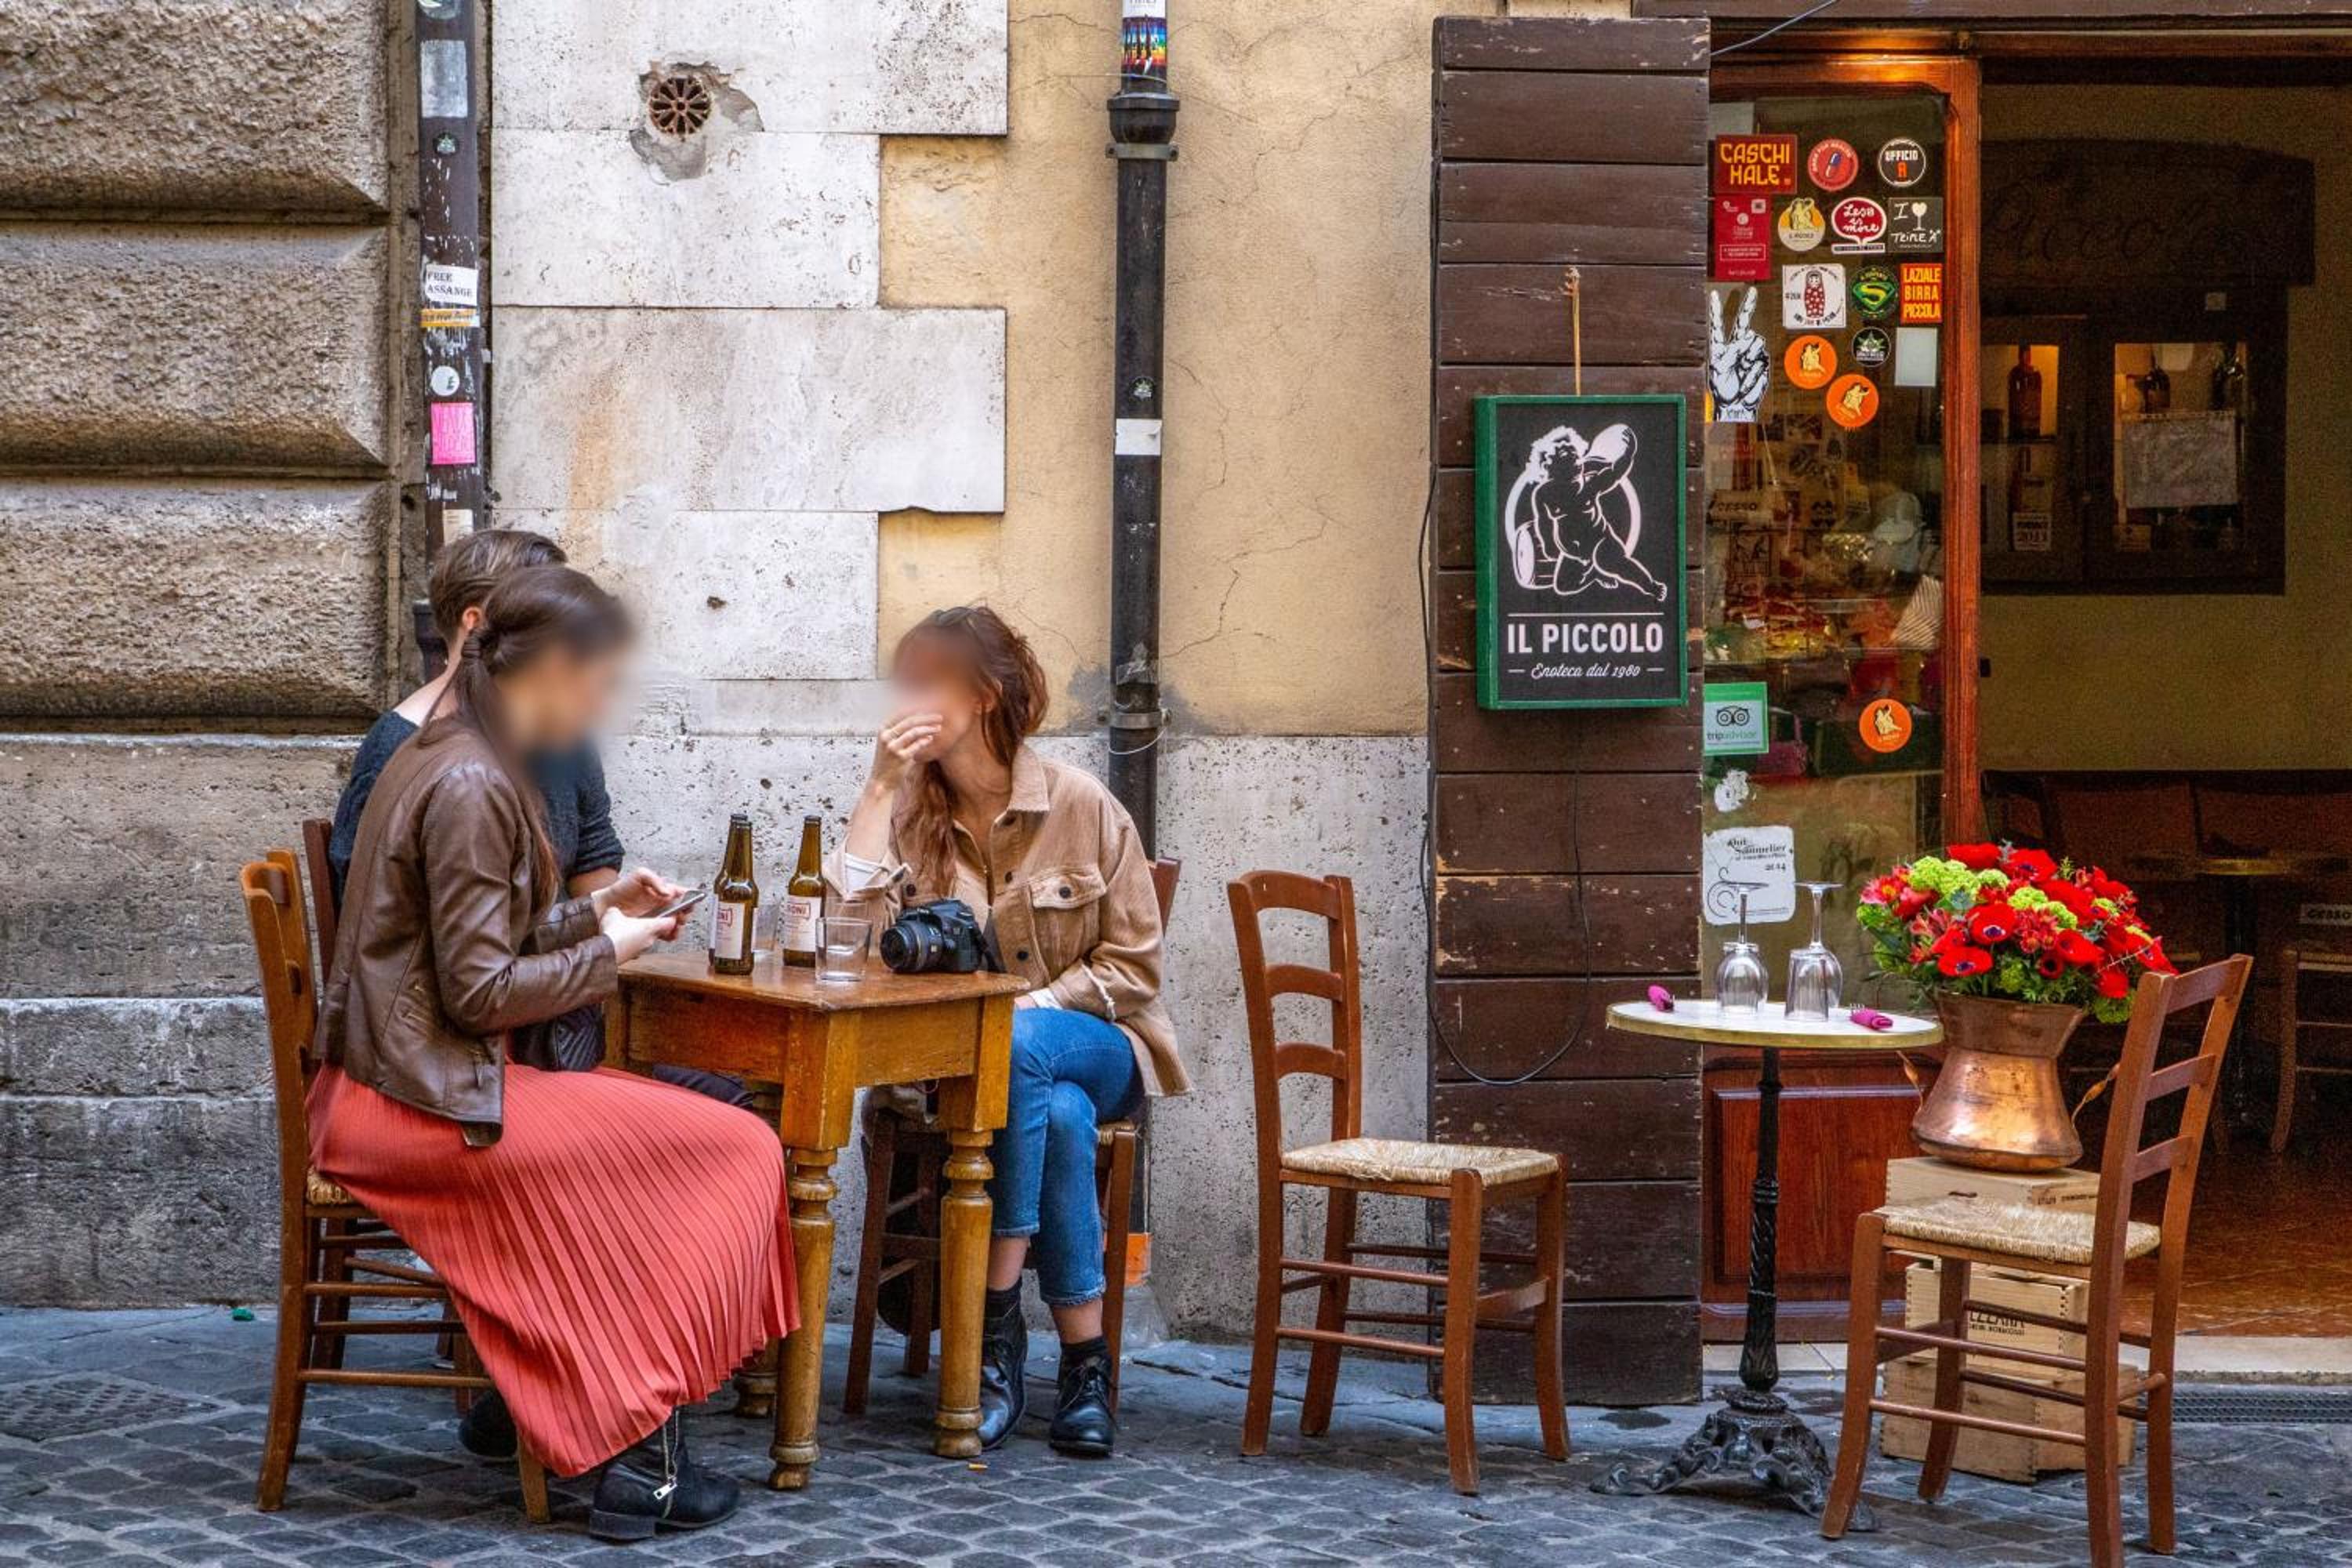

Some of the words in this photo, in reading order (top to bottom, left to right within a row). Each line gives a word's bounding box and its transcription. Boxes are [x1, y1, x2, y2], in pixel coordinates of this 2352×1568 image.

[1719, 143, 1791, 164] CASCHI
[1904, 267, 1941, 282] LAZIALE
[427, 285, 473, 297] ASSANGE
[1904, 285, 1939, 301] BIRRA
[1904, 303, 1942, 319] PICCOLA
[1508, 623, 1533, 654] IL
[1542, 622, 1663, 653] PICCOLO
[1530, 662, 1584, 680] Enoteca
[1586, 662, 1610, 677] dal
